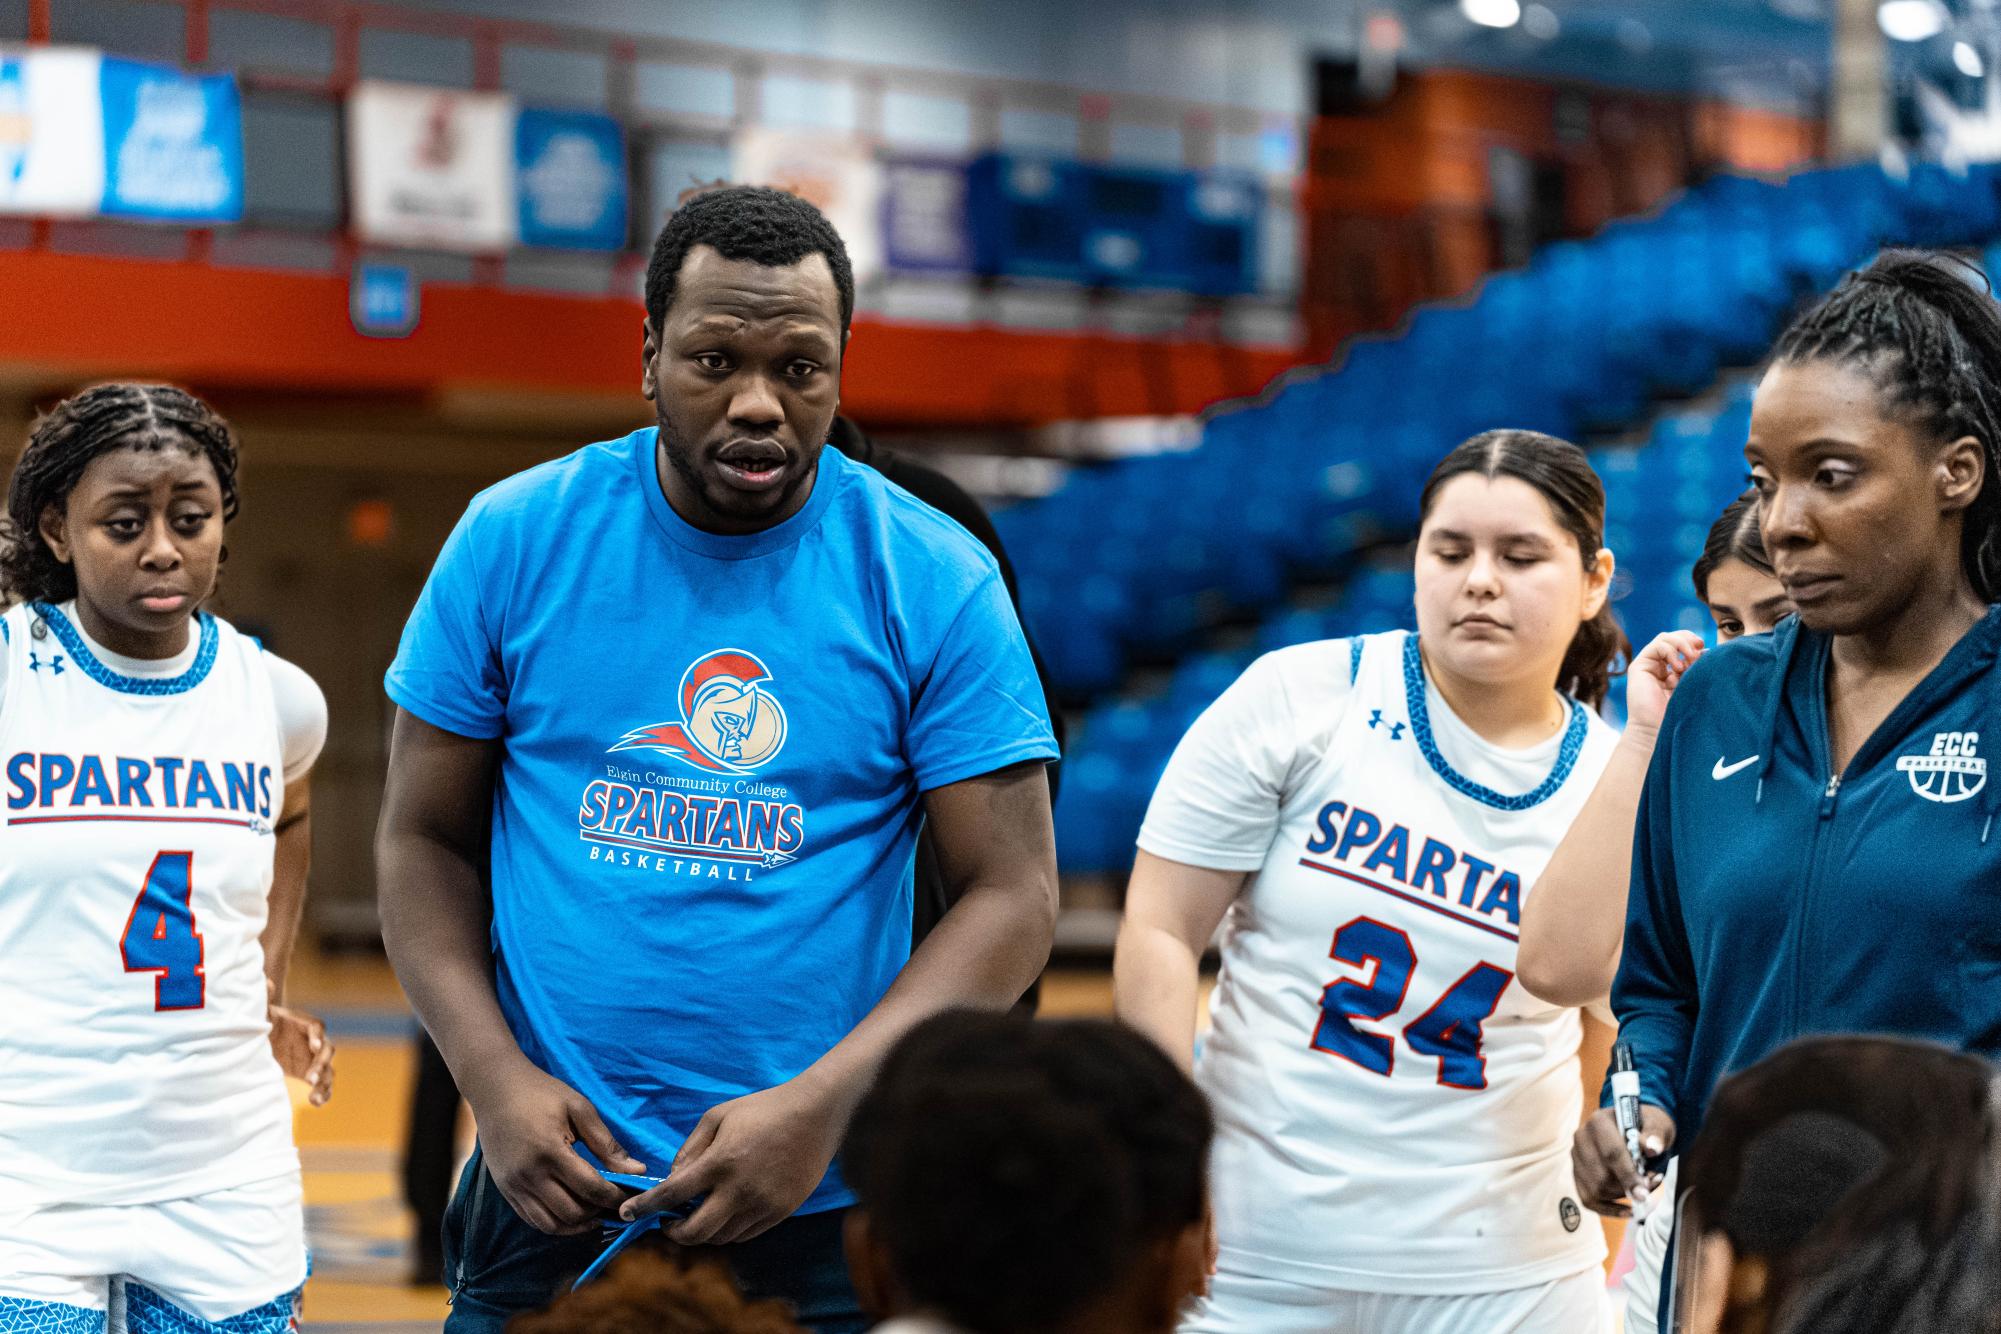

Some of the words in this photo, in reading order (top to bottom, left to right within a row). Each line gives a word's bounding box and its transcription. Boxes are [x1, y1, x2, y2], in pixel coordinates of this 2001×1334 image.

[1929, 731, 1979, 757] ECC
[6, 750, 273, 819] SPARTANS
[579, 779, 804, 854] SPARTANS
[606, 764, 642, 783] Elgin
[646, 771, 730, 794] Community
[734, 780, 787, 799] College
[589, 846, 753, 881] BASKETBALL
[1306, 800, 1521, 928] SPARTA
[119, 849, 206, 1013] 4
[1309, 915, 1515, 1091] 24
